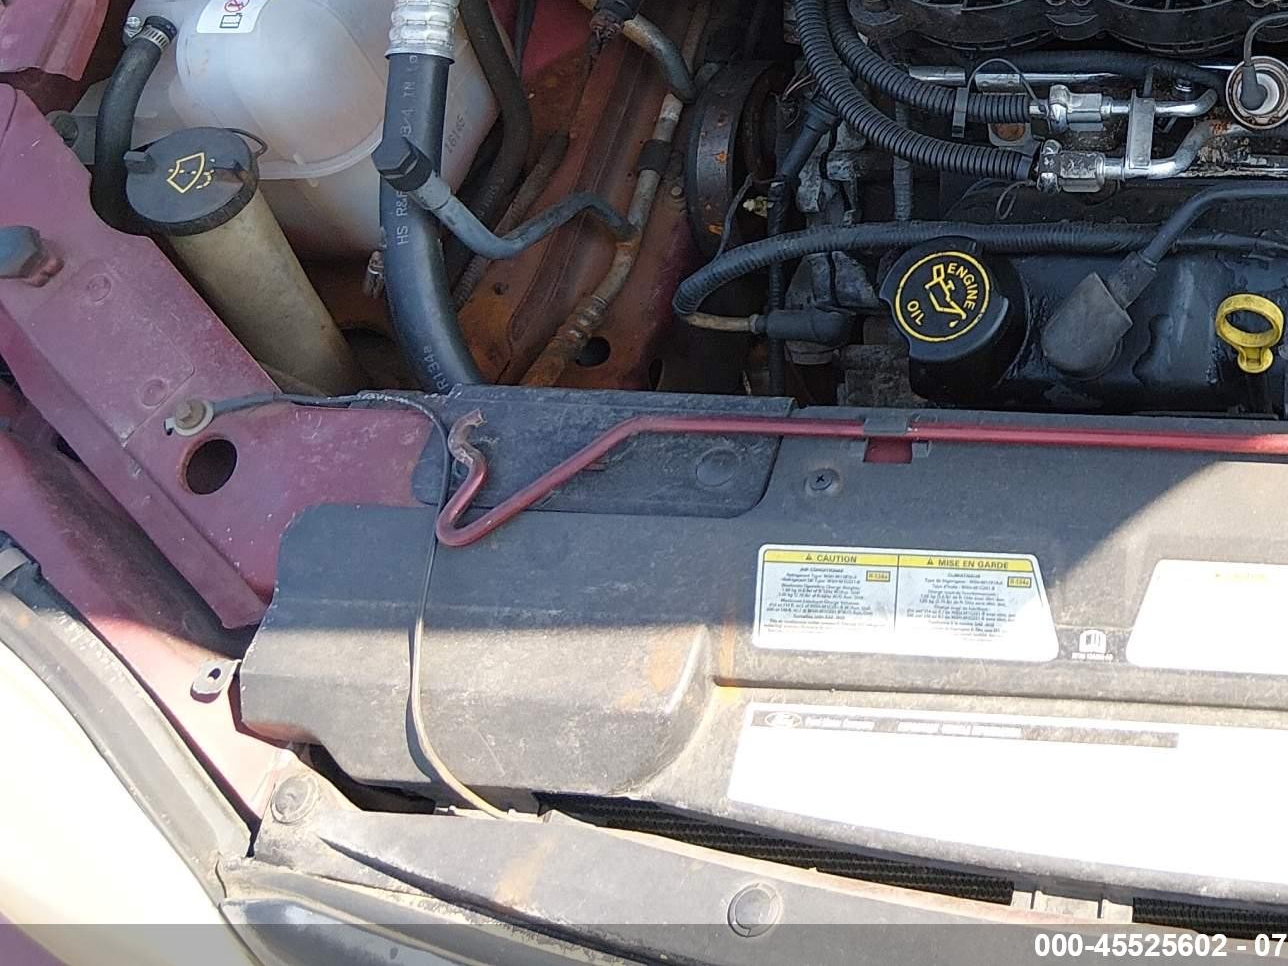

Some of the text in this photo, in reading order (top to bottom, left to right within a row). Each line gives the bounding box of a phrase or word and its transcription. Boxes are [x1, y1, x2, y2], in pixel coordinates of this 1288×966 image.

[906, 262, 979, 326] ENGINE OIL
[816, 554, 857, 563] CAUTION
[938, 559, 1009, 569] MISE EN GARDE
